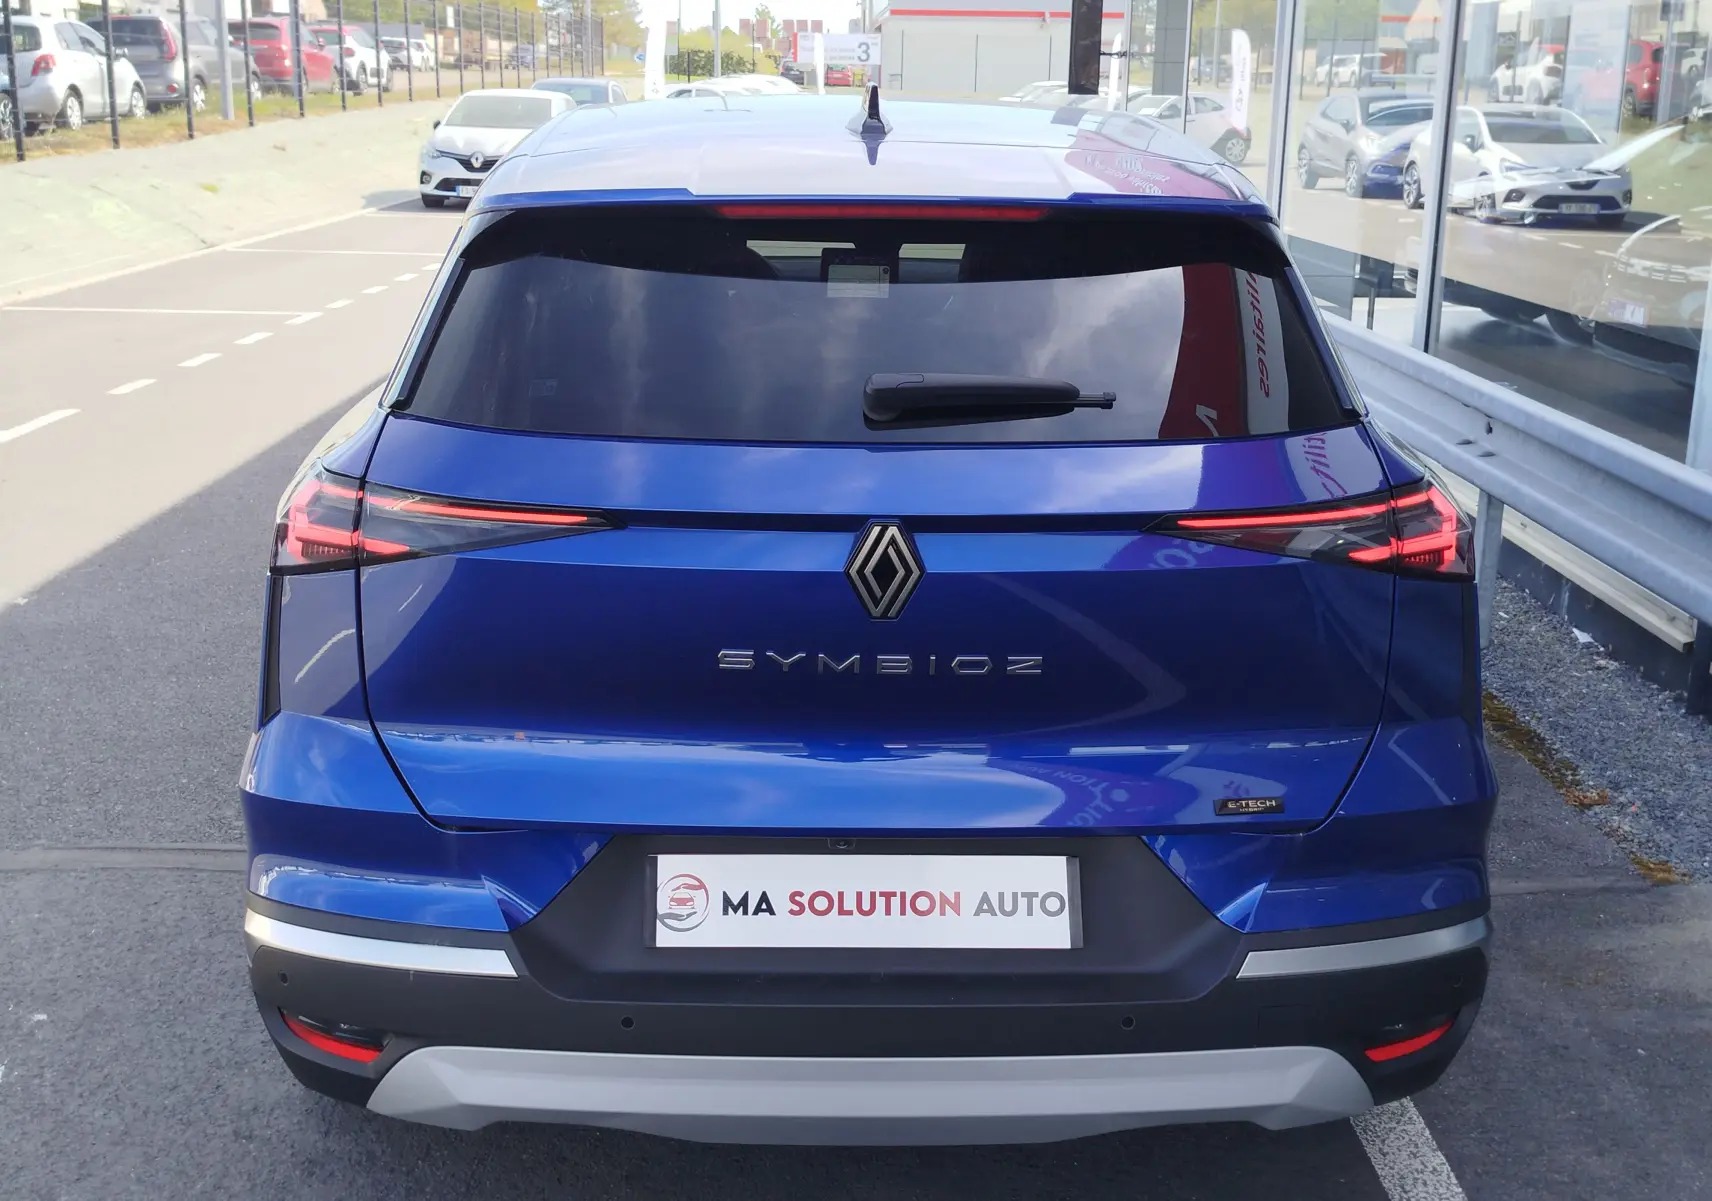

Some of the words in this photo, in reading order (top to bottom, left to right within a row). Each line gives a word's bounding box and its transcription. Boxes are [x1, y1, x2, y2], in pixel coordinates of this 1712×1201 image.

[857, 42, 871, 62] 3
[717, 649, 1043, 675] SYMBIOZ
[1227, 799, 1276, 808] E-TECH
[722, 890, 776, 916] MA
[788, 890, 962, 917] SOLUTION
[973, 891, 1067, 918] AUTO
